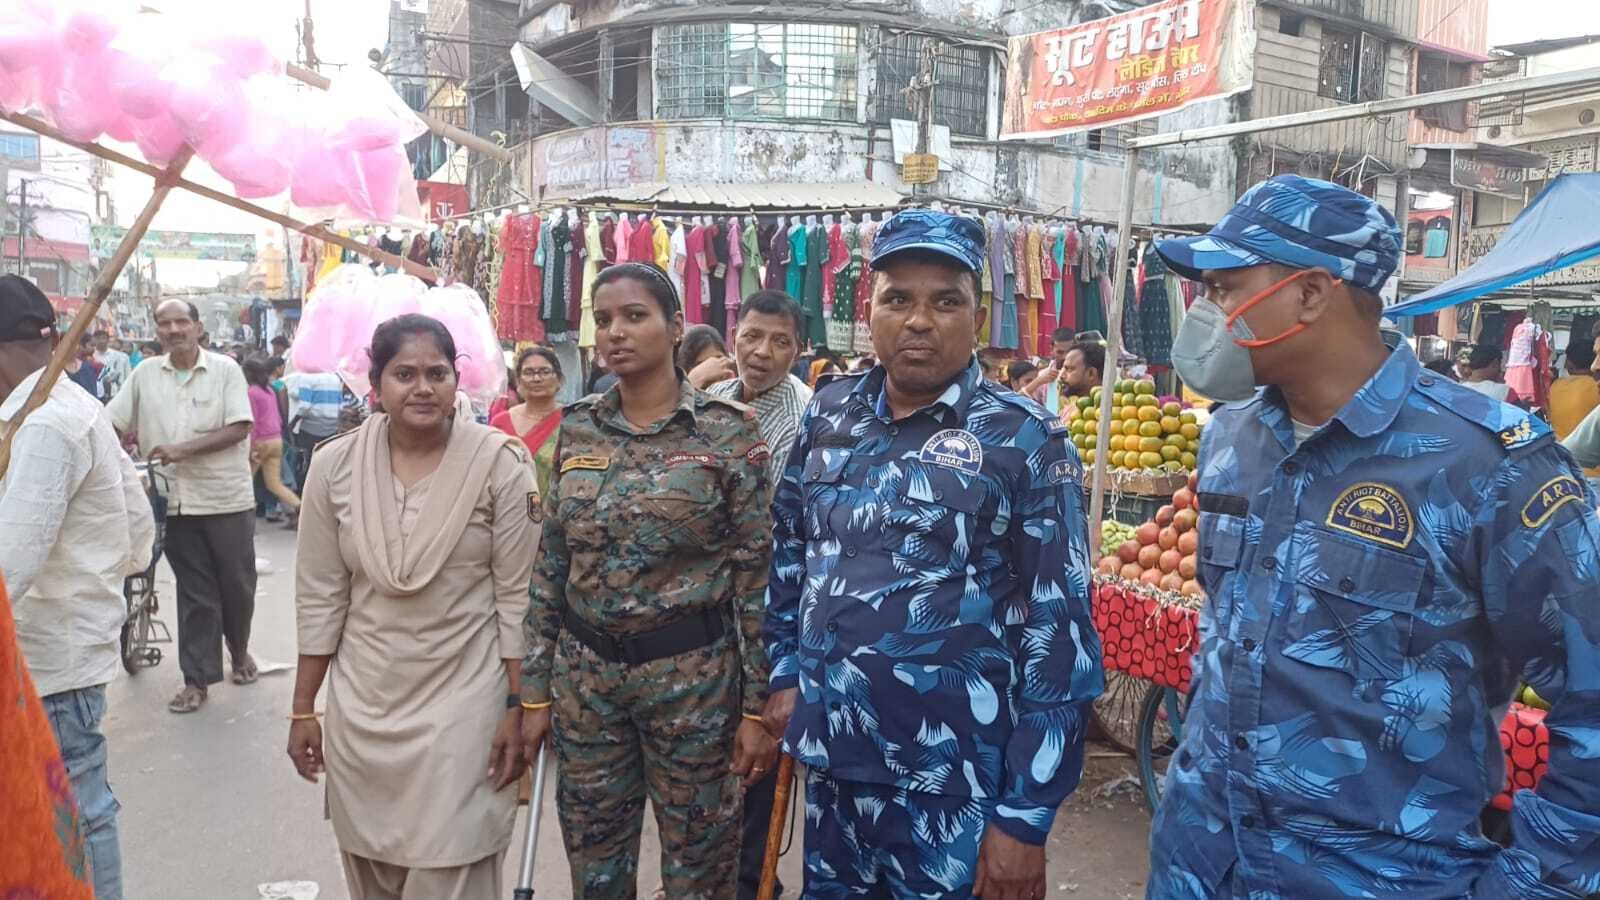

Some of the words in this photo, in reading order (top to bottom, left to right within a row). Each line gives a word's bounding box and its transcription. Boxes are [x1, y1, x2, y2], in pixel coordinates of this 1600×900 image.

[1045, 29, 1100, 87] सूट
[935, 455, 964, 468] BIHAR
[1336, 496, 1352, 516] ANTI
[1353, 487, 1374, 499] RIOT
[1374, 487, 1409, 533] BATTALION
[1349, 519, 1383, 536] BIHAR
